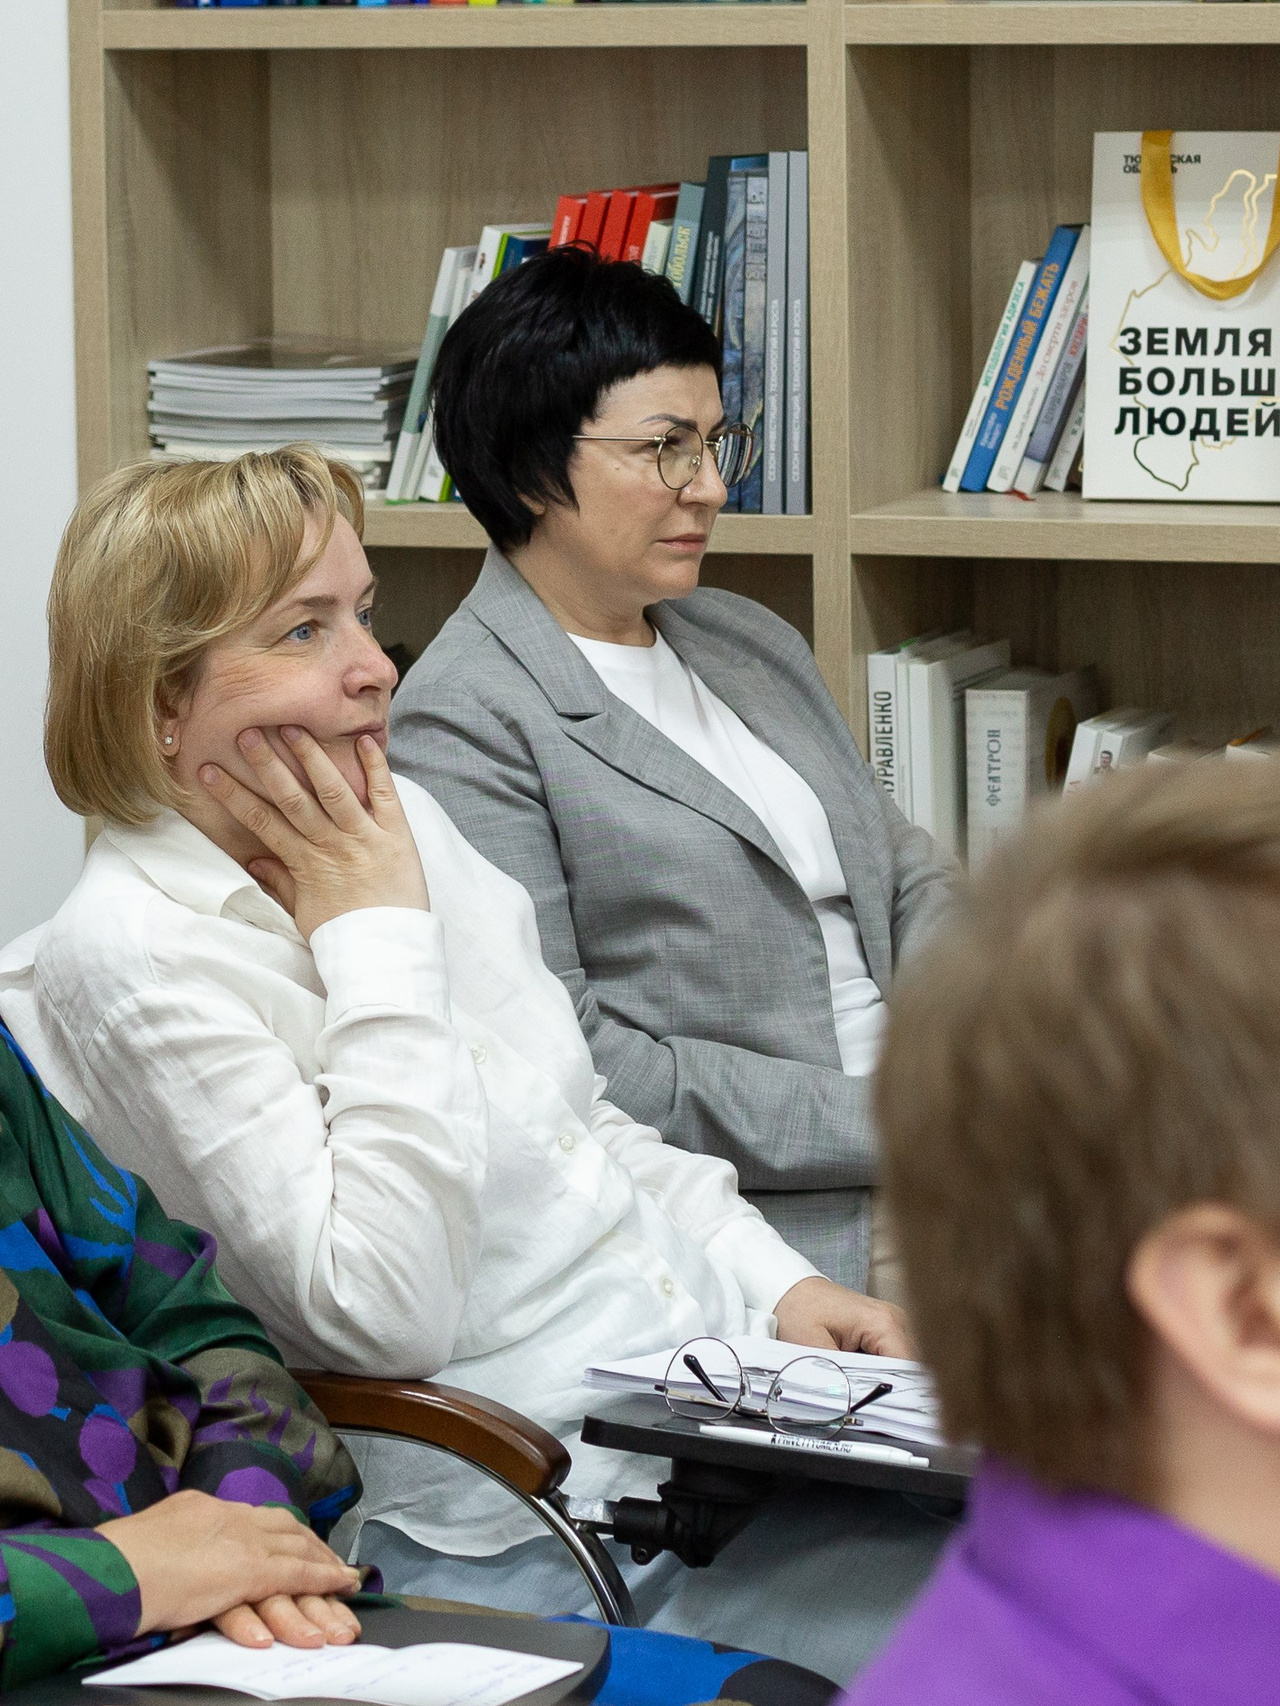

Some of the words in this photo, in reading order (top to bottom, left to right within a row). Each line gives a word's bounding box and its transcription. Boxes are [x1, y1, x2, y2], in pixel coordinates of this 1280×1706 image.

[1123, 154, 1201, 164] ТЮСКАЯ
[771, 299, 780, 328] РОСТА
[792, 299, 802, 328] РОСТА
[982, 322, 1009, 388] МЕТОДОЛОГИЯ
[1006, 281, 1026, 322] АДИЗЕСА
[994, 319, 1038, 411] РОЖДЕННЫЙ
[1028, 261, 1060, 319] БЕЖАТЬ
[1118, 327, 1272, 357] ЗЕМЛЯ
[768, 452, 777, 482] СЕЗОН
[791, 452, 801, 482] СЕЗОН
[873, 690, 895, 794] УРАВЛЕНКО
